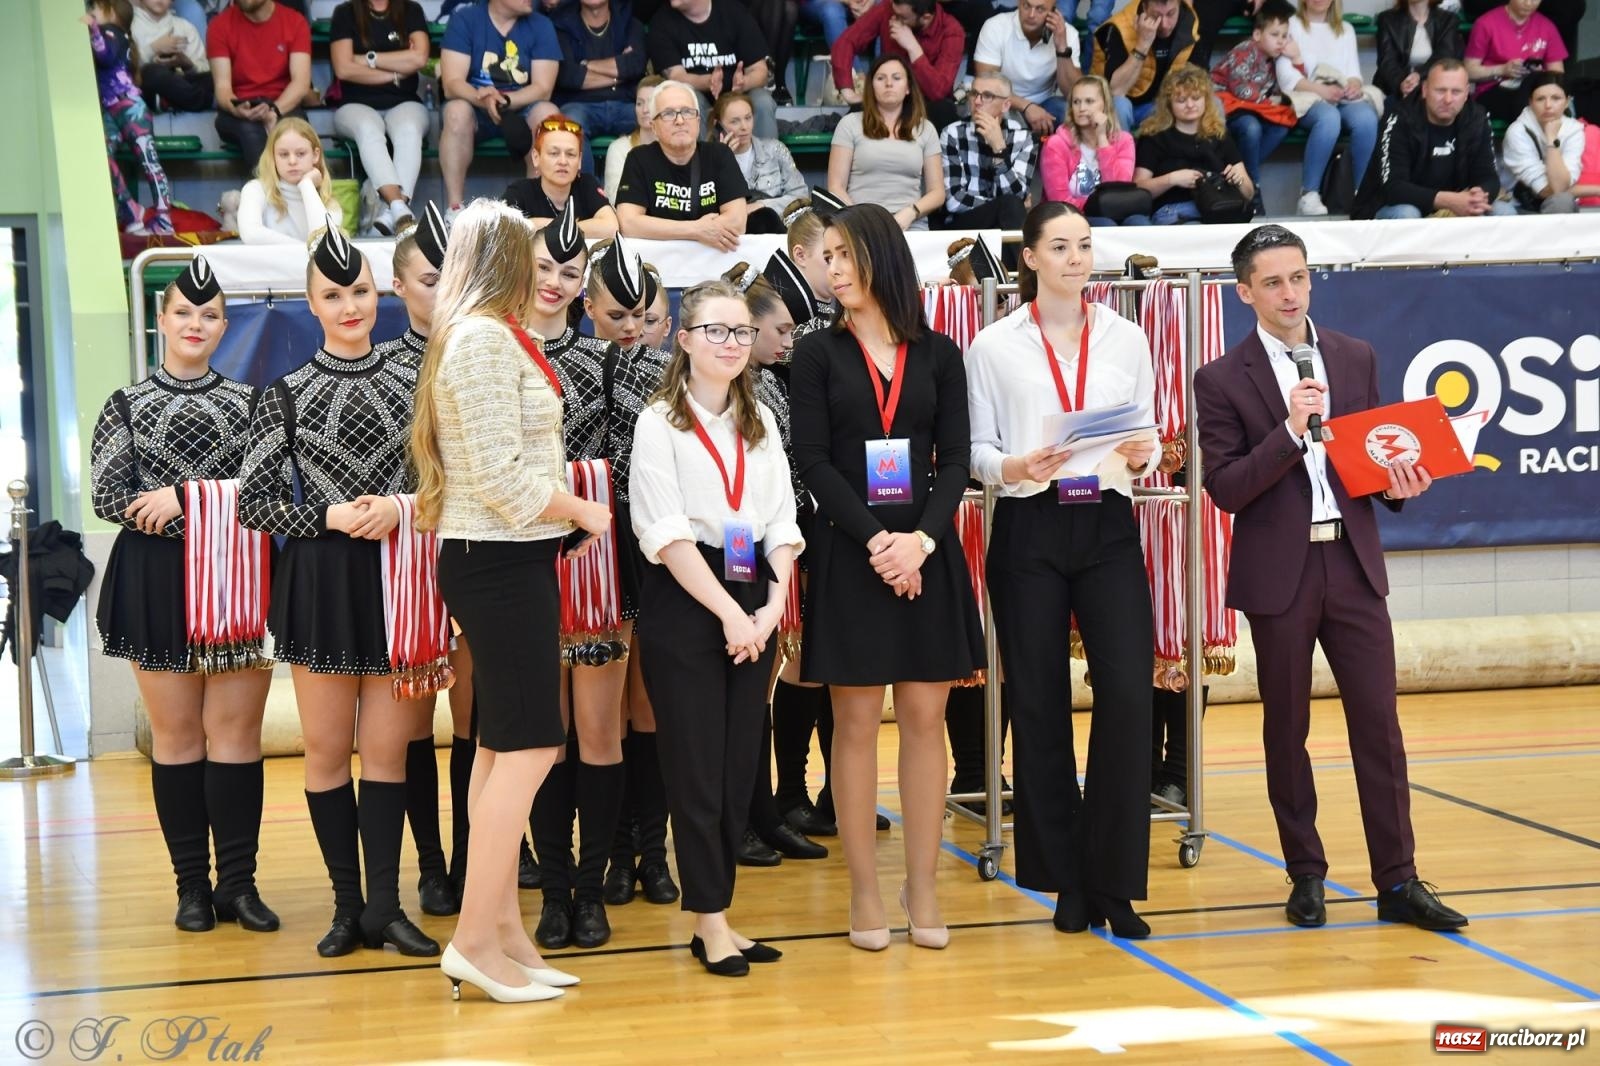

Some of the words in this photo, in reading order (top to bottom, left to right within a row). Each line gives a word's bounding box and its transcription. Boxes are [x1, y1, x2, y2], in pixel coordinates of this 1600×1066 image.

[688, 43, 718, 56] TATA
[655, 181, 716, 199] STROER
[655, 195, 692, 212] FASTE
[700, 194, 717, 207] and
[1519, 446, 1599, 474] RACI
[877, 488, 903, 496] SĘDZIA
[1067, 489, 1092, 497] SĘDZIA
